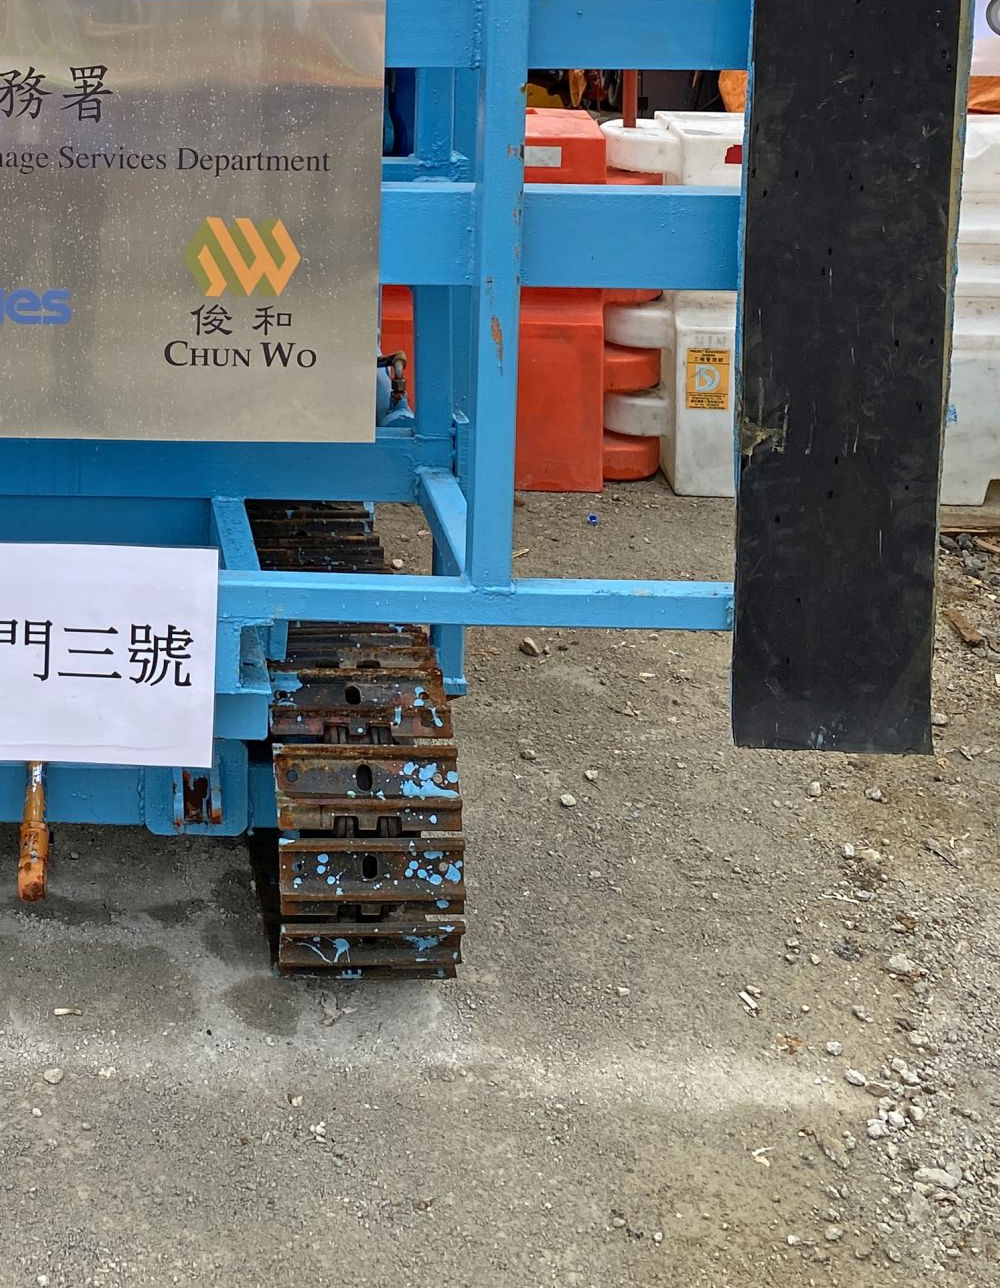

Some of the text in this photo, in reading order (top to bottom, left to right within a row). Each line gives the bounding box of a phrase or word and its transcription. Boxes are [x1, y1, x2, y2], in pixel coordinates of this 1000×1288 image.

[58, 146, 167, 170] Services
[177, 147, 331, 177] Department
[190, 304, 293, 336] 俊和
